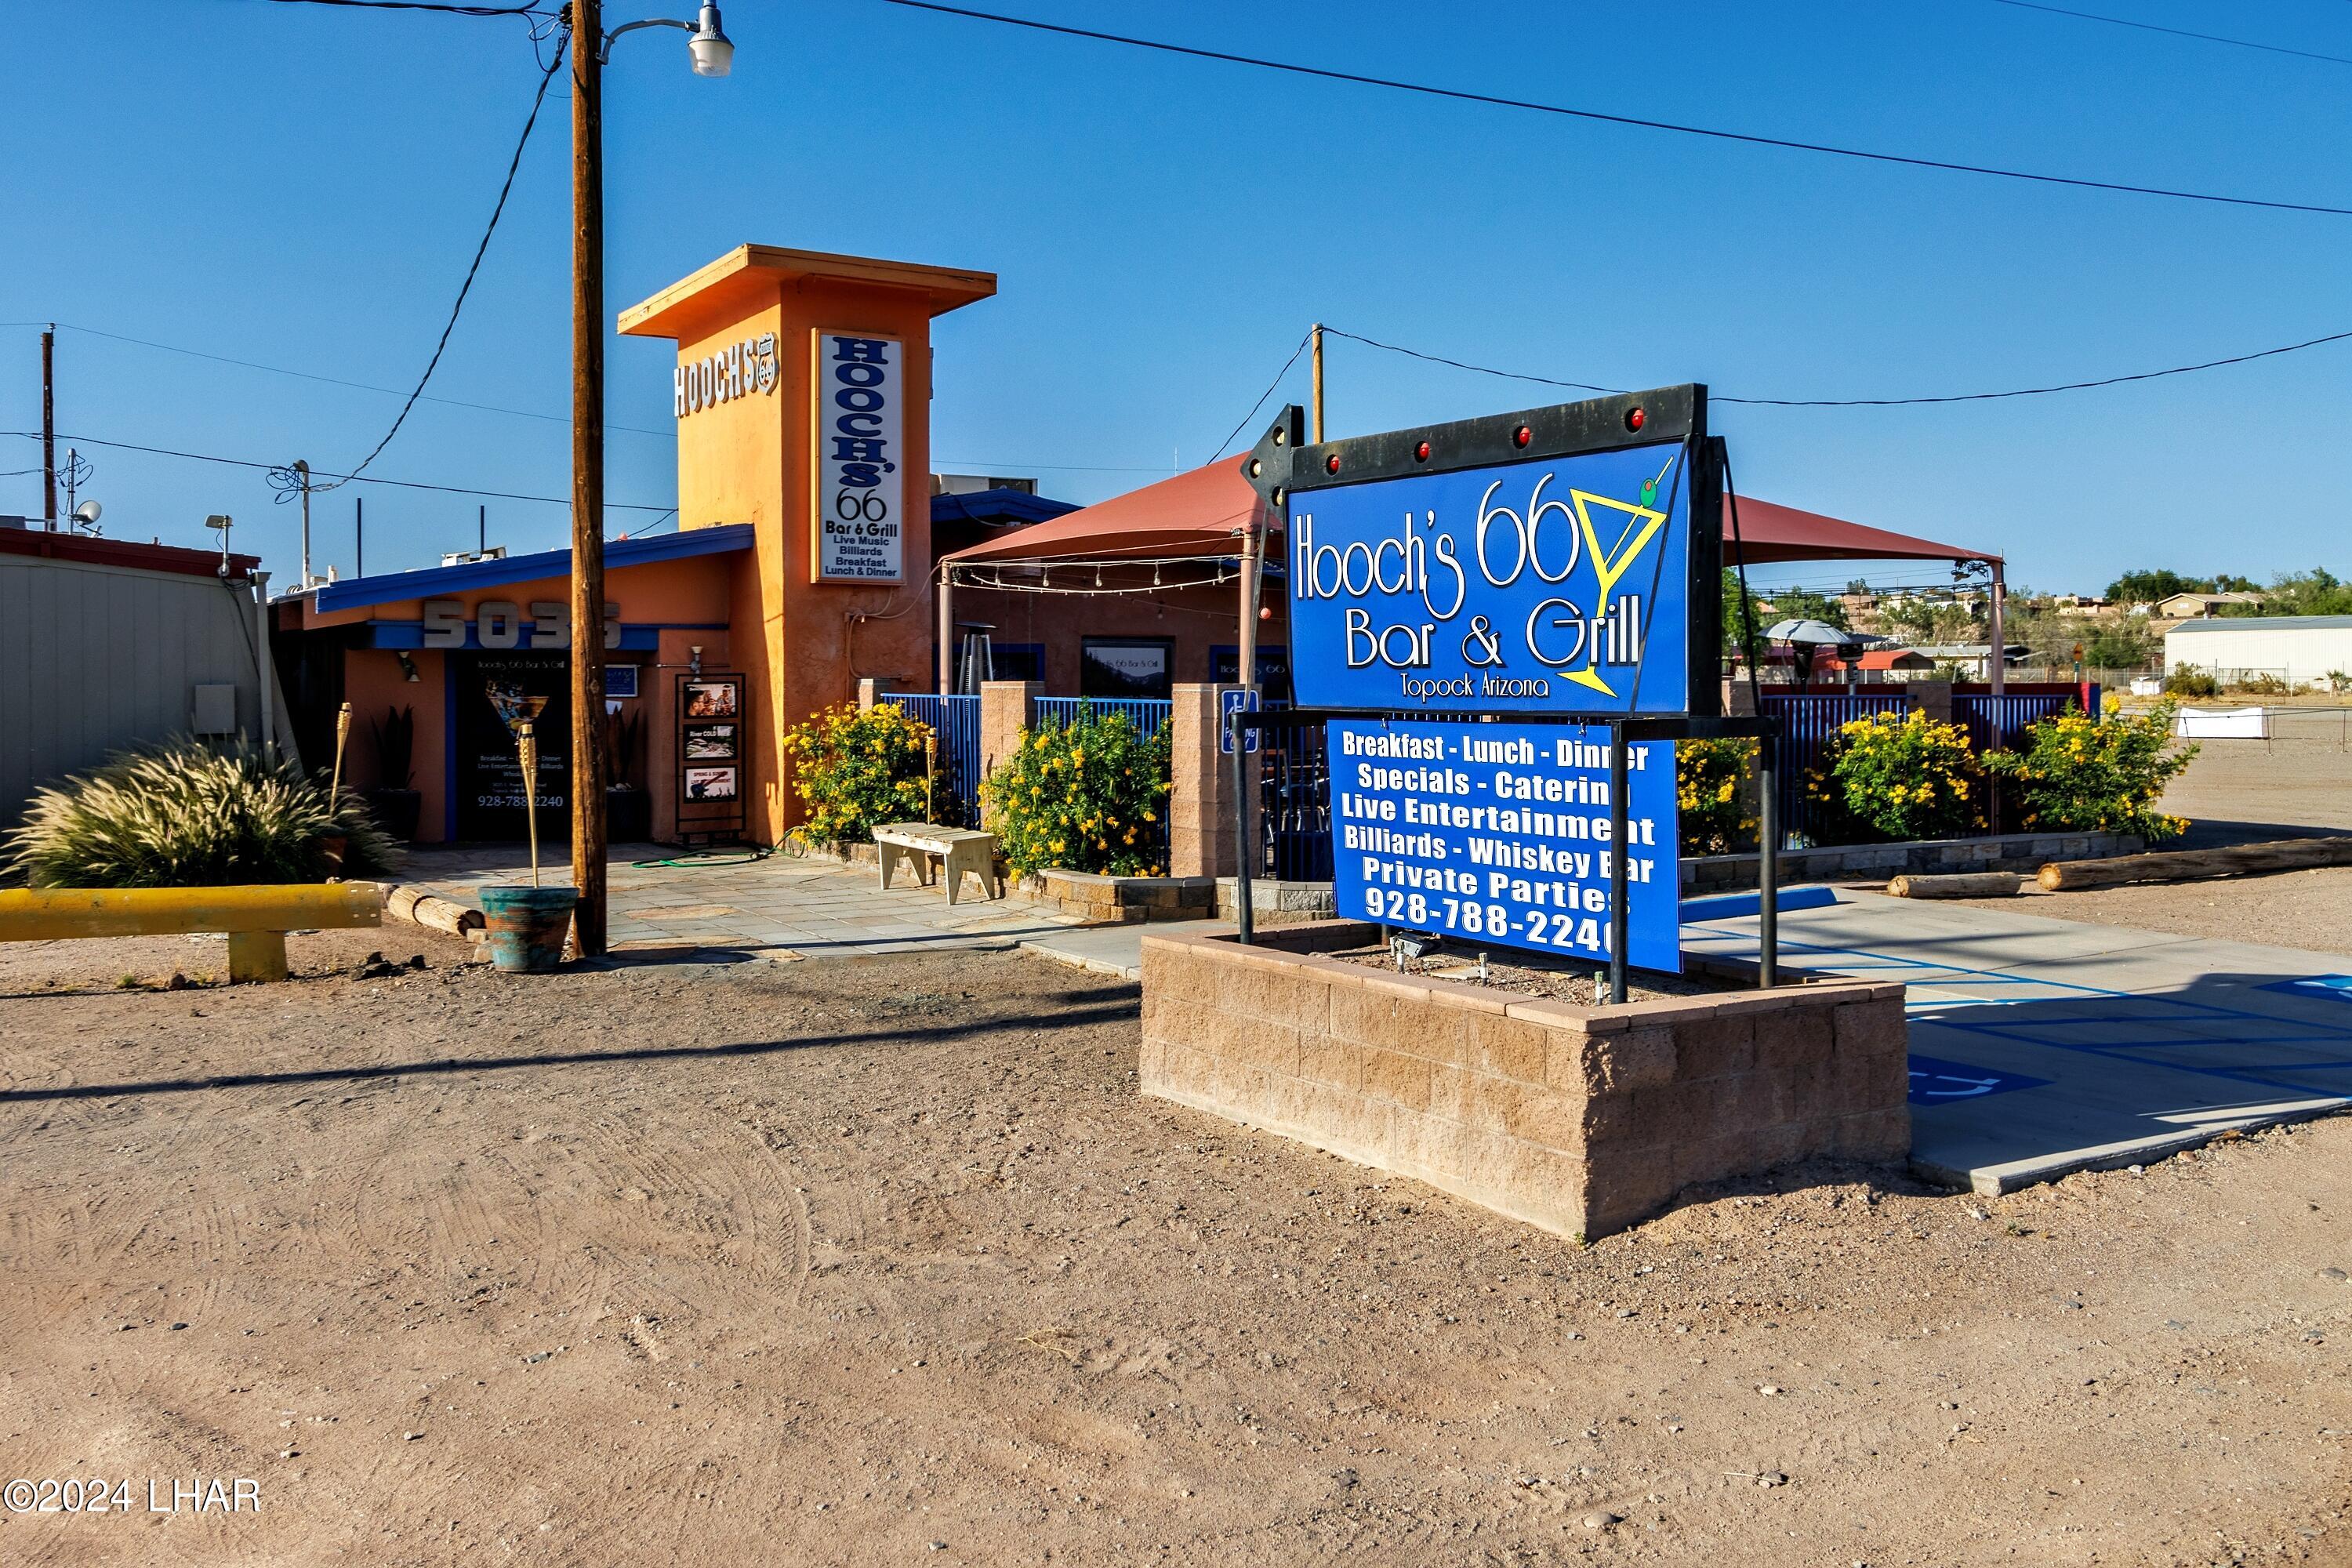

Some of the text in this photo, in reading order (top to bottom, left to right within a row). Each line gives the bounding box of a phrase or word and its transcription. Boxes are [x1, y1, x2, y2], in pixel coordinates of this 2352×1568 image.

[674, 339, 757, 418] HOOCHS
[831, 336, 895, 488] HOOCH'S
[836, 487, 887, 522] 66
[826, 521, 897, 537] Bar & Grill
[833, 535, 890, 546] Live Music
[1296, 473, 1581, 619] Hooch's 66
[836, 557, 887, 567] Breakfast
[840, 546, 883, 556] Billiards
[826, 565, 898, 577] Lunch & Dinner
[1345, 594, 1639, 667] Bar & Grill
[1400, 670, 1548, 703] Topock Arizona
[1343, 730, 1444, 761] Breakfast
[1463, 735, 1534, 765] Lunch
[477, 796, 564, 807] 928-7882240
[1358, 762, 1470, 795] Specials
[1495, 771, 1631, 808] Caterin
[1342, 793, 1396, 822] Live
[1344, 824, 1446, 860] Billiards
[1468, 837, 1591, 880] Whiskey
[1363, 856, 1478, 896] Private
